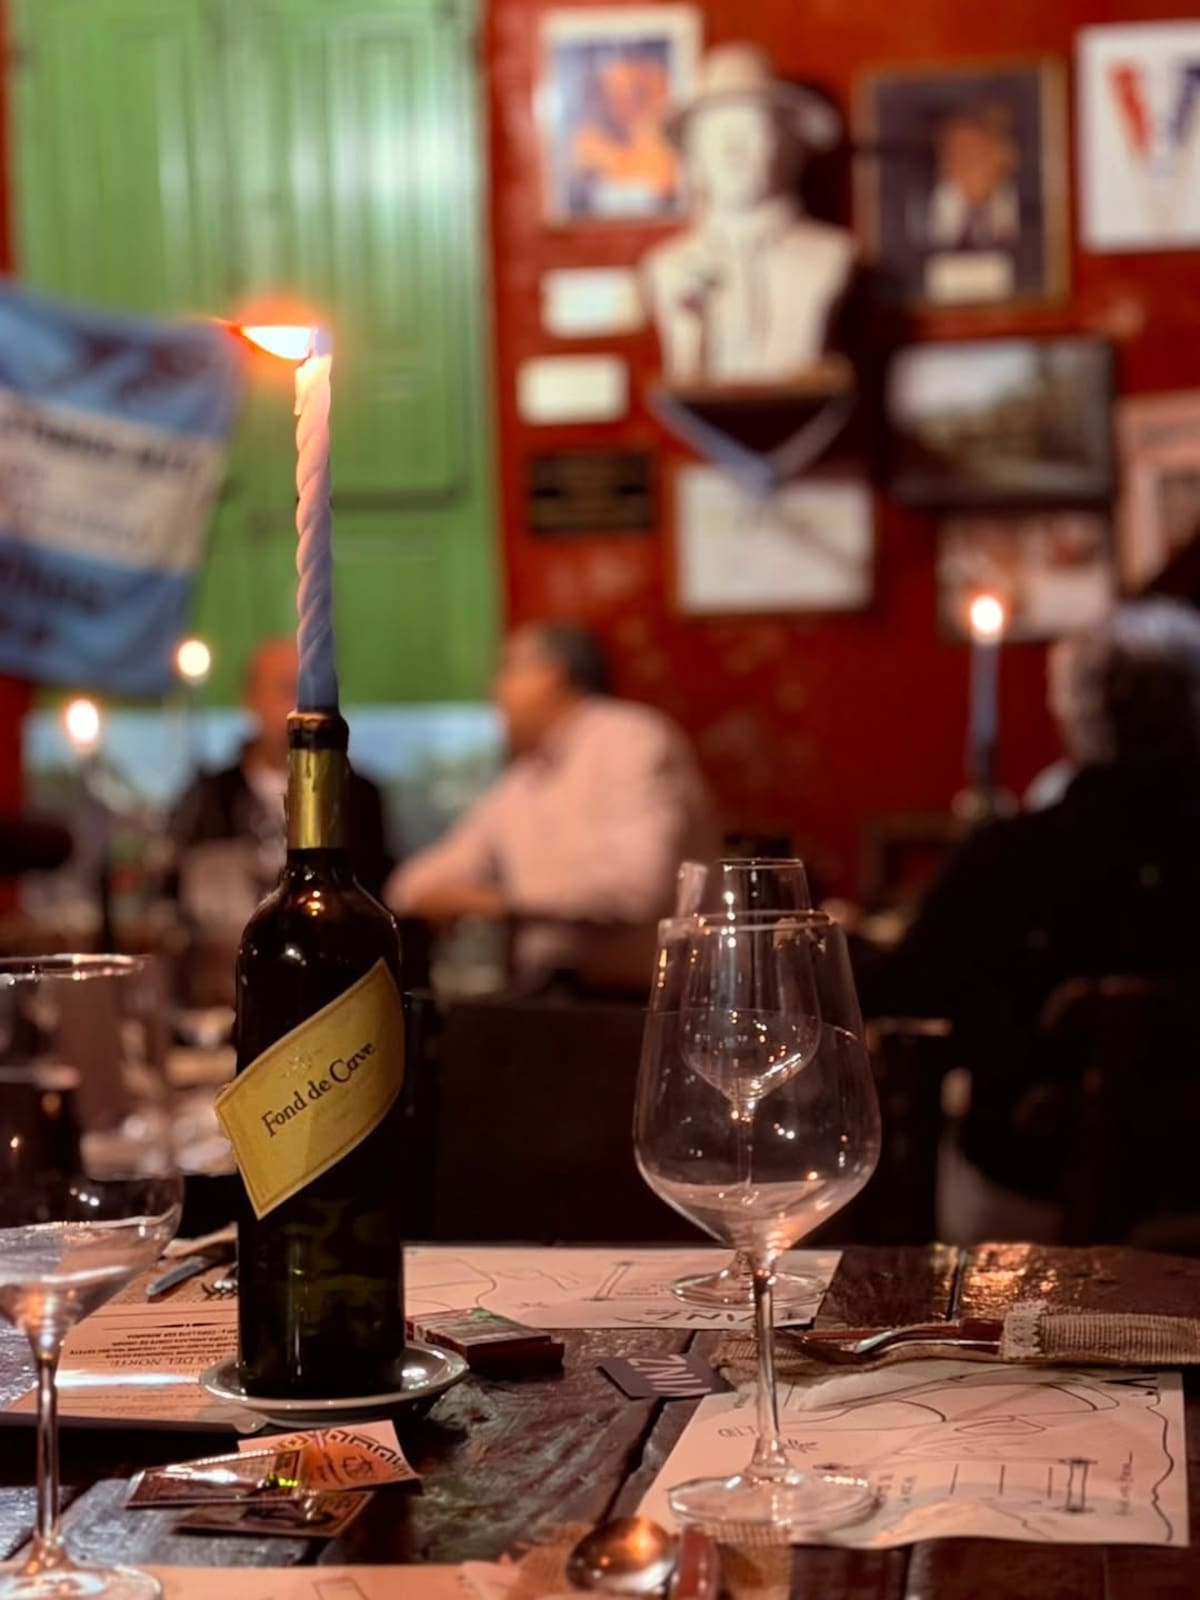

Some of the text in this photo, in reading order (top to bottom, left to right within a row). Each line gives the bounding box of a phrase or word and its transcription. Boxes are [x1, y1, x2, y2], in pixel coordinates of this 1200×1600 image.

[261, 1042, 376, 1138] Fond de Cave
